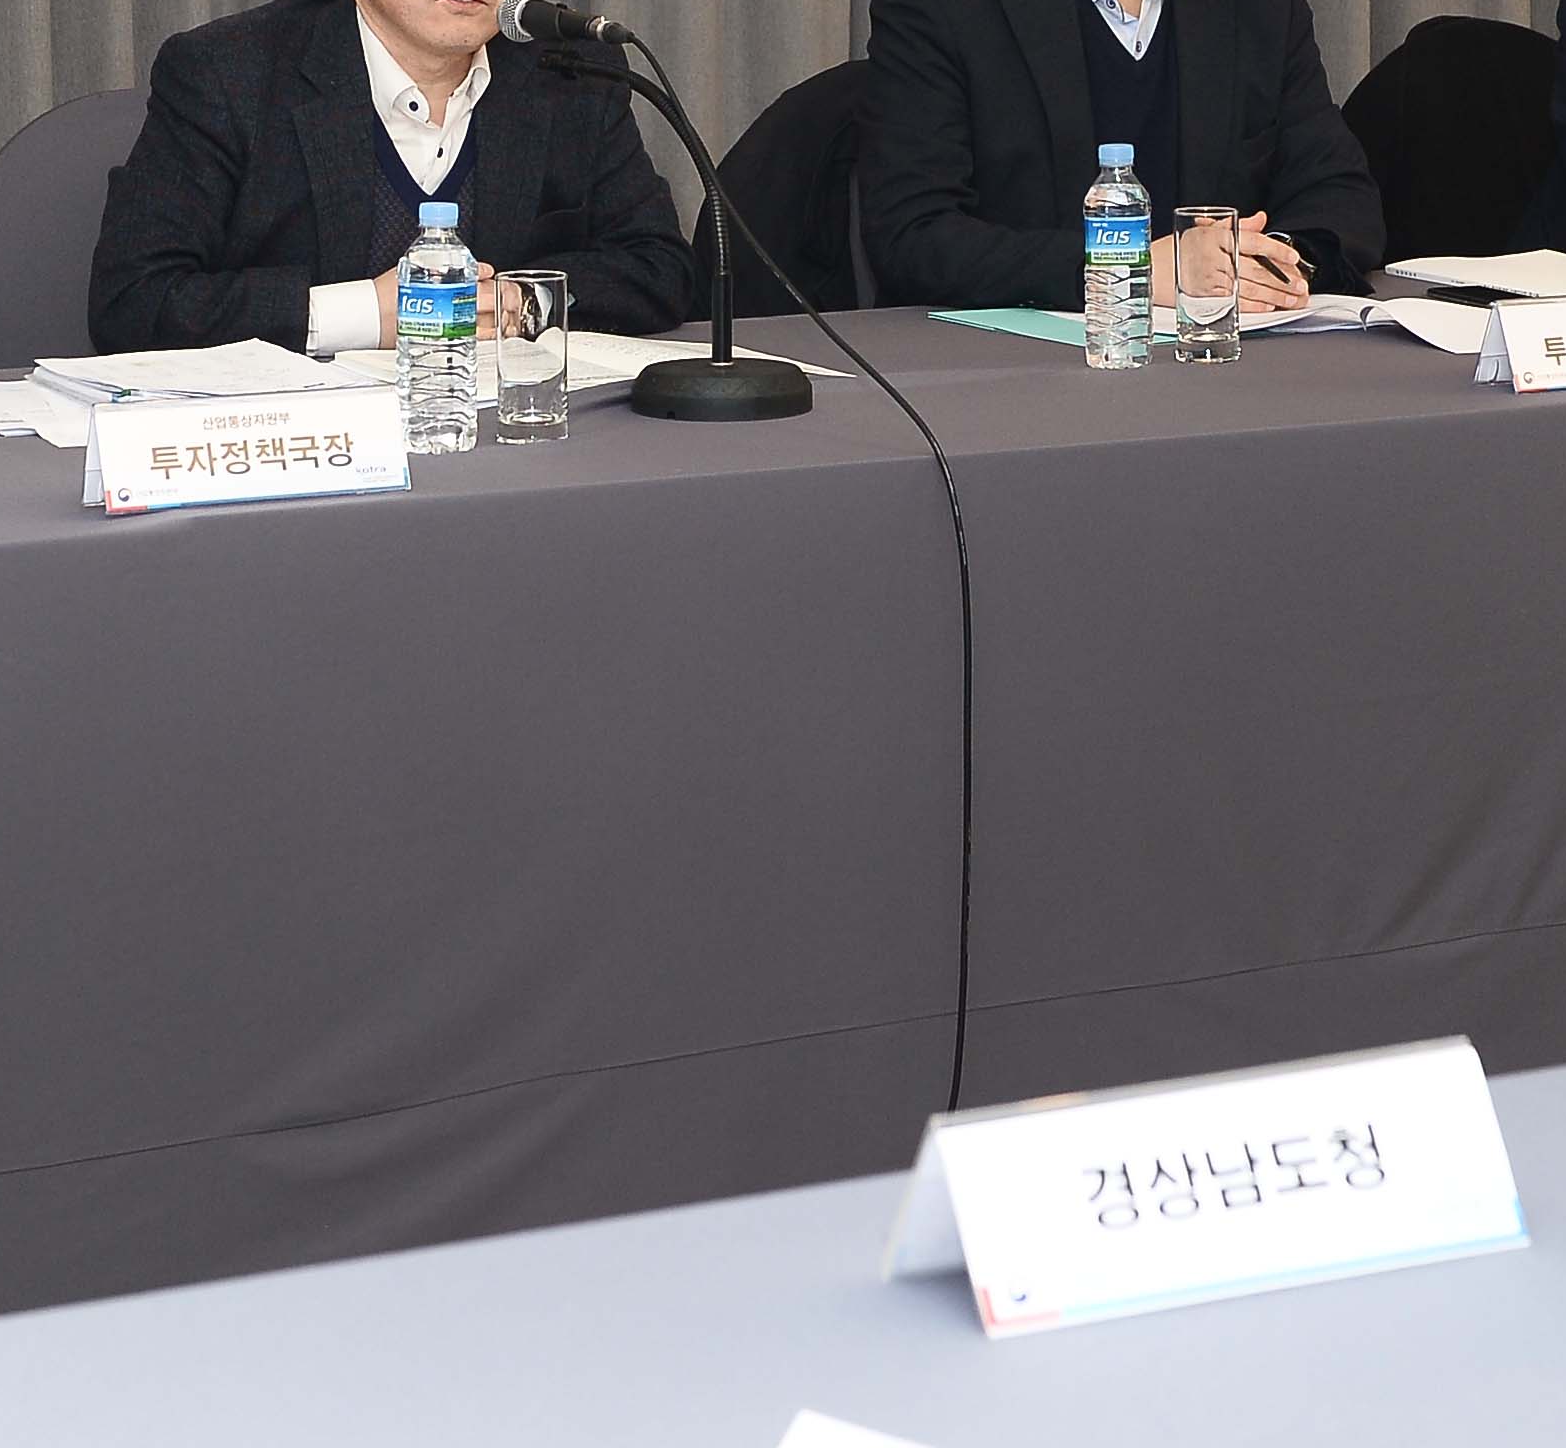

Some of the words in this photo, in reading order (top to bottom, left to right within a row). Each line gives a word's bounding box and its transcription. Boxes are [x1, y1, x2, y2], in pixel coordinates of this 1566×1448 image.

[202, 412, 291, 431] 산업통상자원부
[149, 432, 354, 480] 투자정책국장
[1082, 1123, 1385, 1229] 경상남도청
